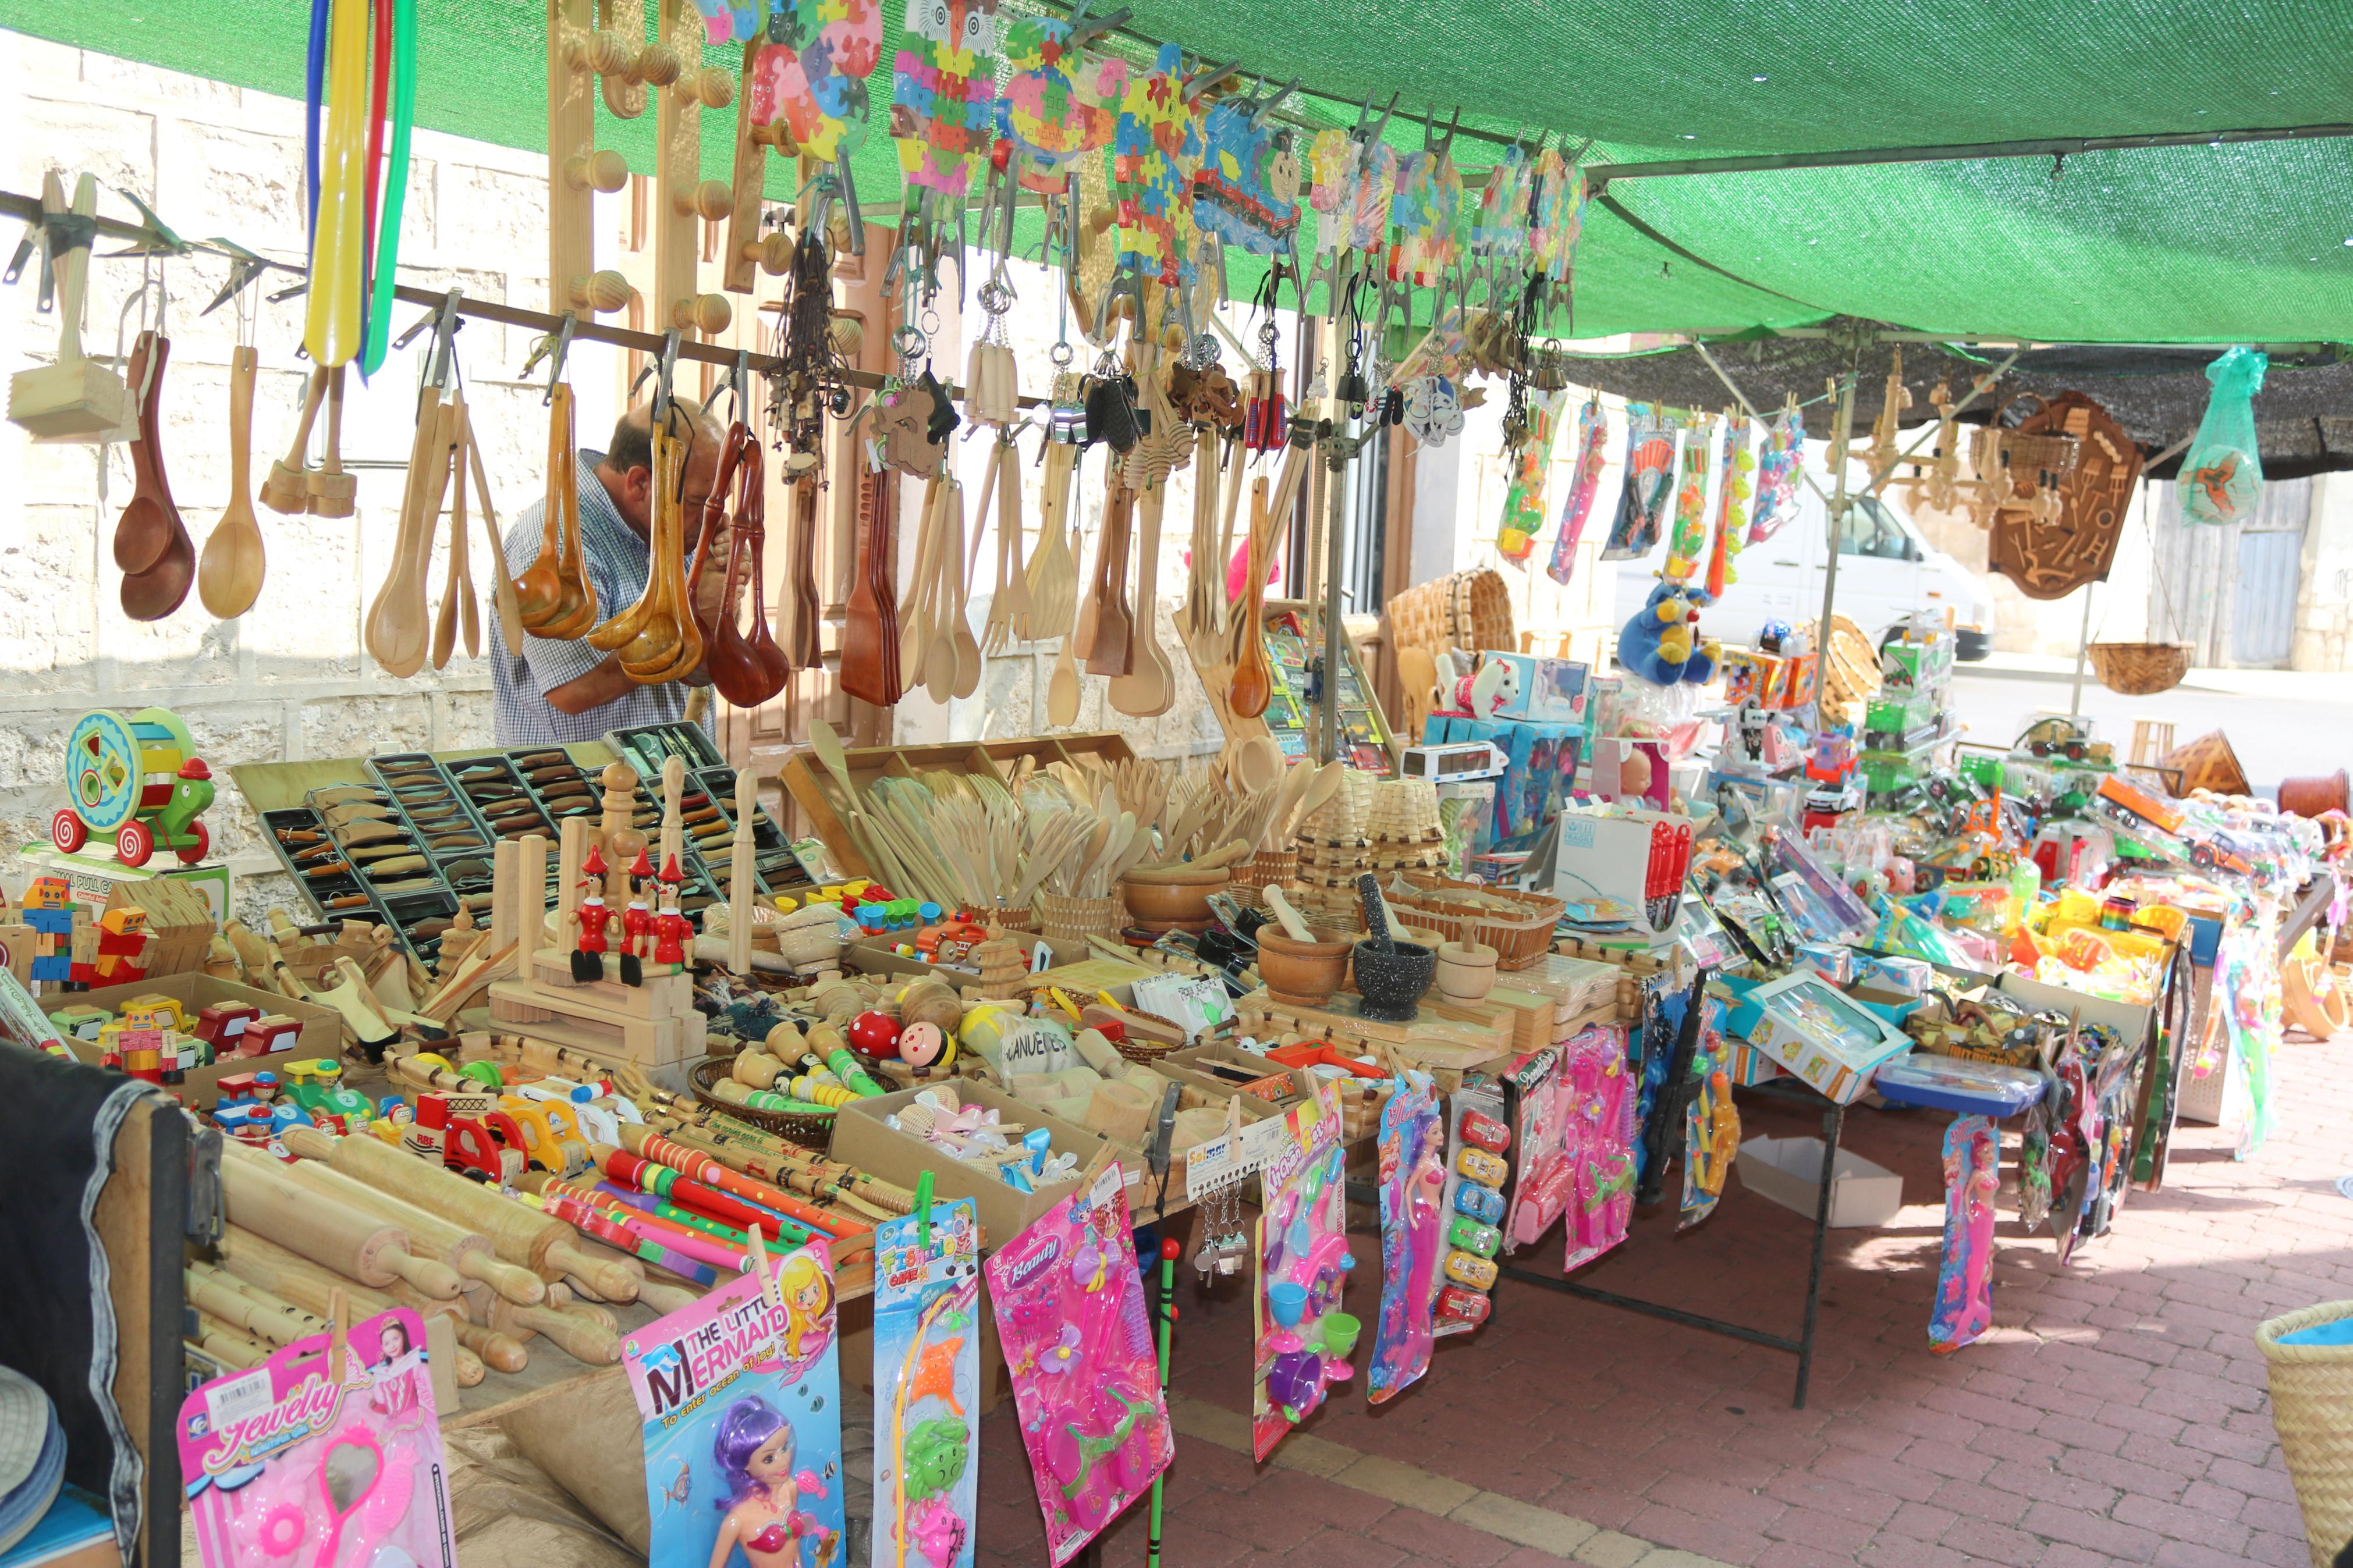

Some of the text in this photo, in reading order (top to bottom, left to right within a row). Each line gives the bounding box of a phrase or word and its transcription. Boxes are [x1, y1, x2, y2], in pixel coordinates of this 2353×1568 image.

[1564, 833, 1593, 844] FRAGILE
[77, 876, 99, 893] PULL
[77, 892, 95, 902] Colorful
[1165, 946, 1181, 958] NOIX
[417, 1134, 434, 1148] RBE
[1189, 1143, 1226, 1167] Solmar
[1265, 1142, 1303, 1203] Kitchen
[1301, 1122, 1324, 1157] Set
[884, 1229, 892, 1239] 3+
[881, 1237, 956, 1276] FISHING
[1012, 1238, 1058, 1285] Beauty
[889, 1267, 918, 1287] GAME
[685, 1283, 781, 1358] THE LITTL
[646, 1304, 787, 1415] MERMAID
[661, 1341, 776, 1430] To enter ocean of joy!
[291, 1424, 310, 1439] GIRL
[1055, 1528, 1067, 1545] CE
